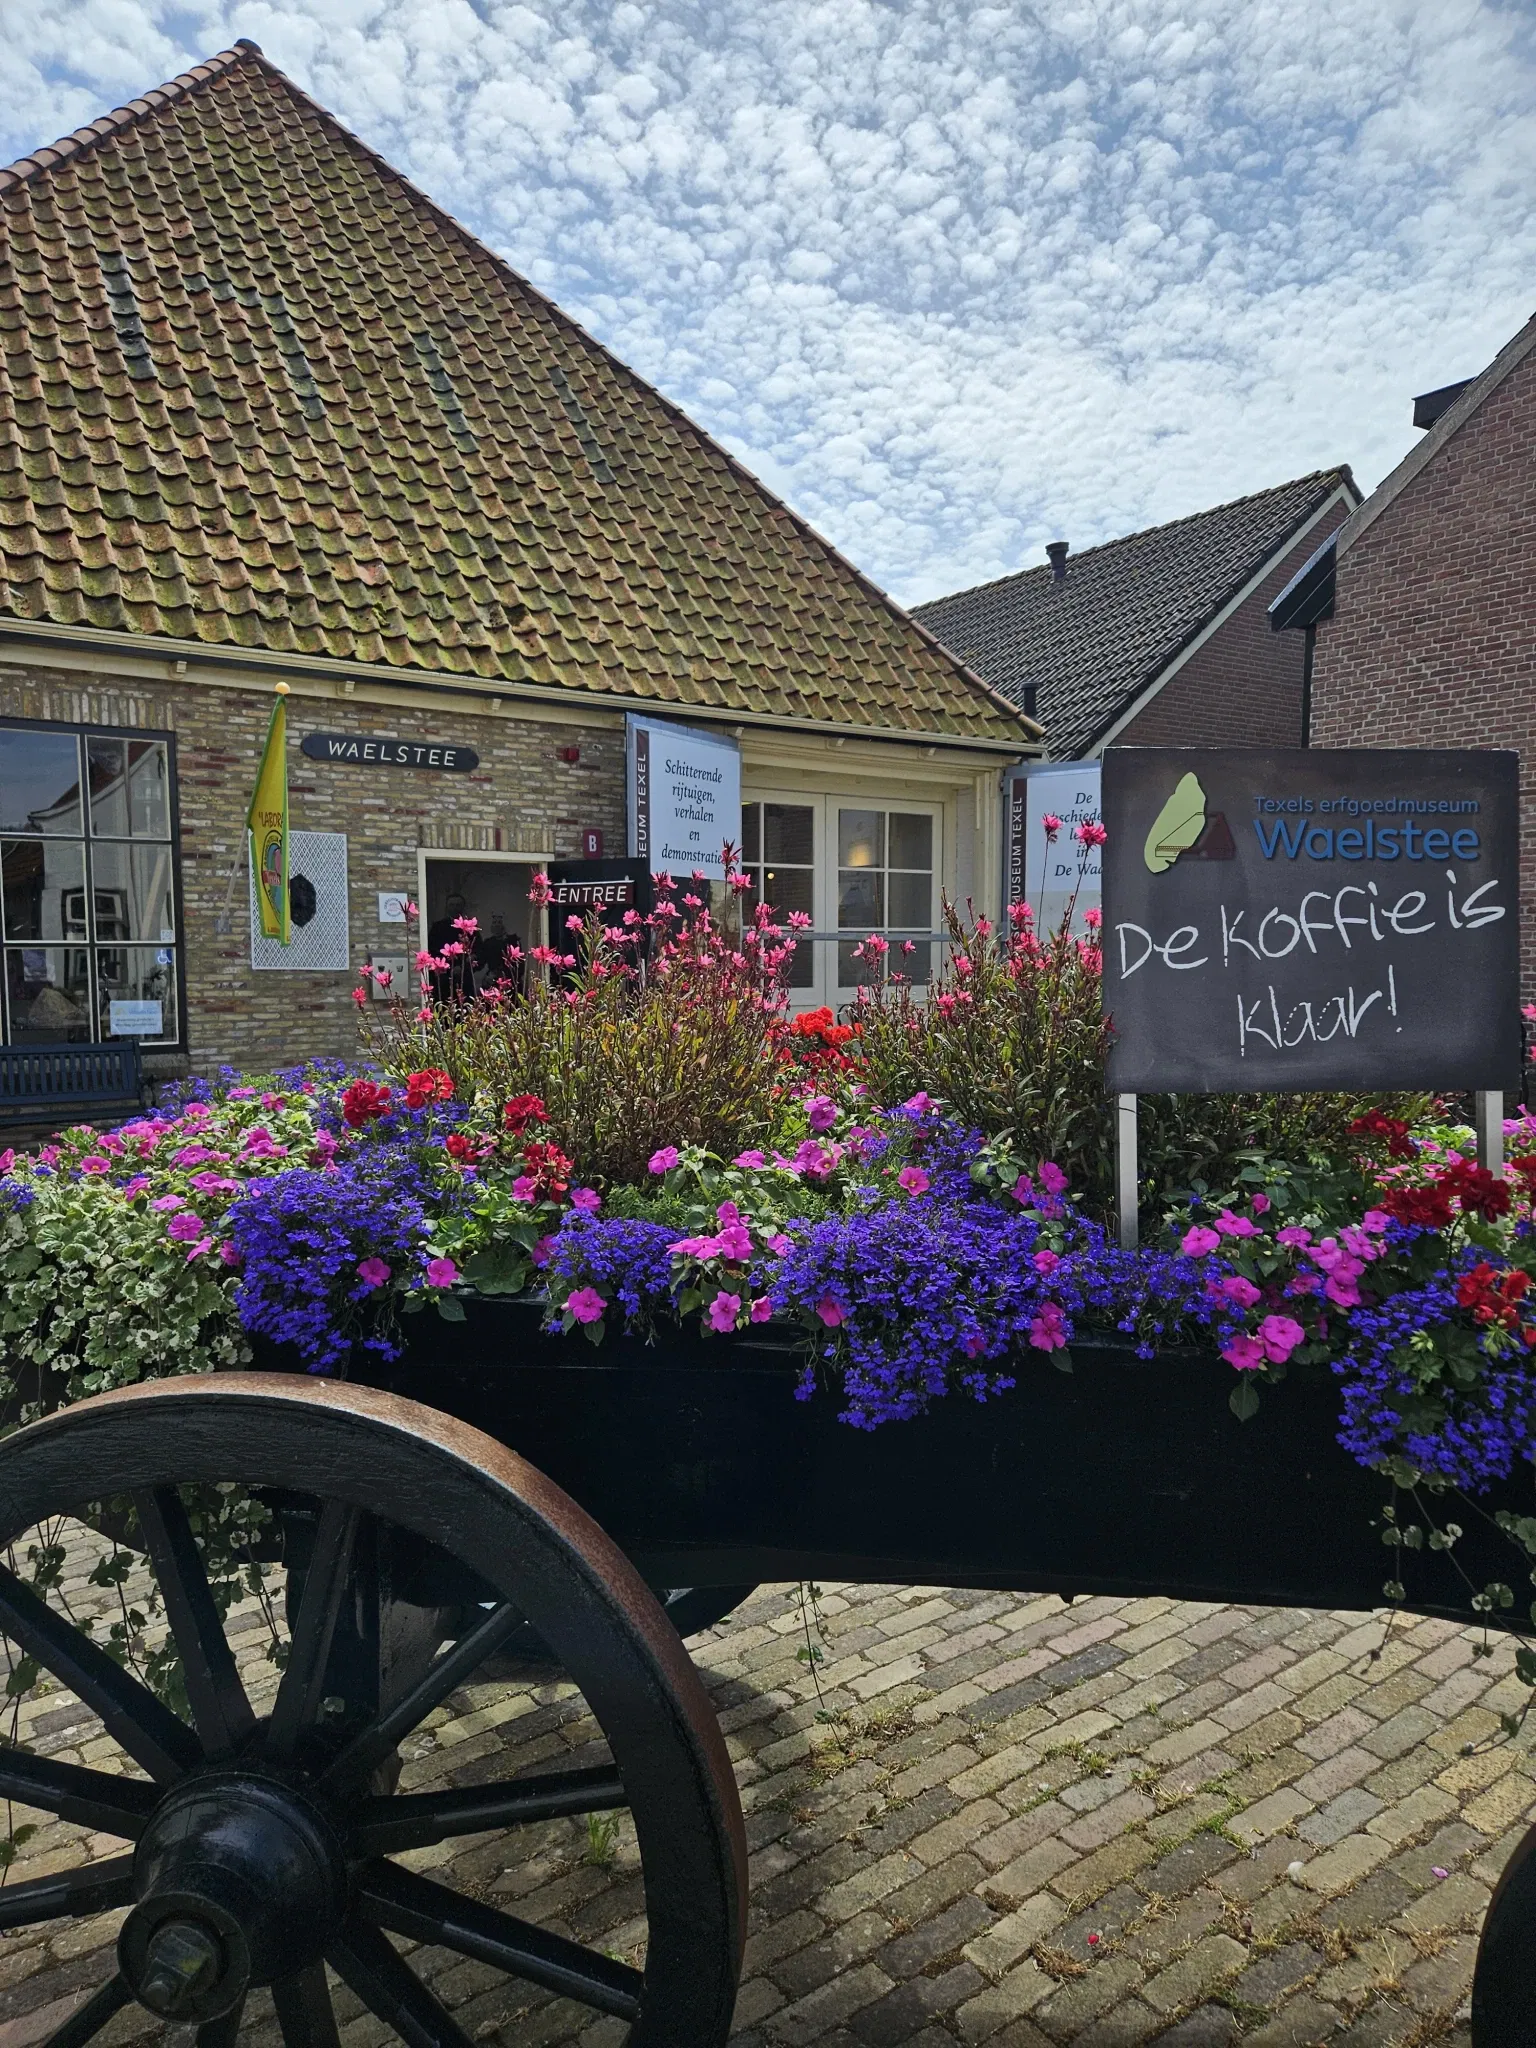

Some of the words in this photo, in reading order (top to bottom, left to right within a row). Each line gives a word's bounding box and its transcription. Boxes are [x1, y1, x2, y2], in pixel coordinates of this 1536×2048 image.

[328, 740, 457, 767] WAELSTEE
[637, 753, 646, 806] TEXEL
[664, 759, 723, 784] Schitterende
[672, 781, 716, 804] rijtuigen,
[1075, 792, 1093, 805] De
[674, 804, 714, 823] verhalen
[1254, 796, 1314, 813] Texels
[1319, 796, 1479, 817] erfgoedmuseum
[1012, 797, 1023, 840] TEXEL
[588, 834, 597, 852] B
[689, 829, 700, 841] en
[1252, 819, 1479, 860] Waelstee
[1054, 864, 1073, 877] De
[557, 885, 628, 904] ENTREE
[1115, 923, 1208, 979] De
